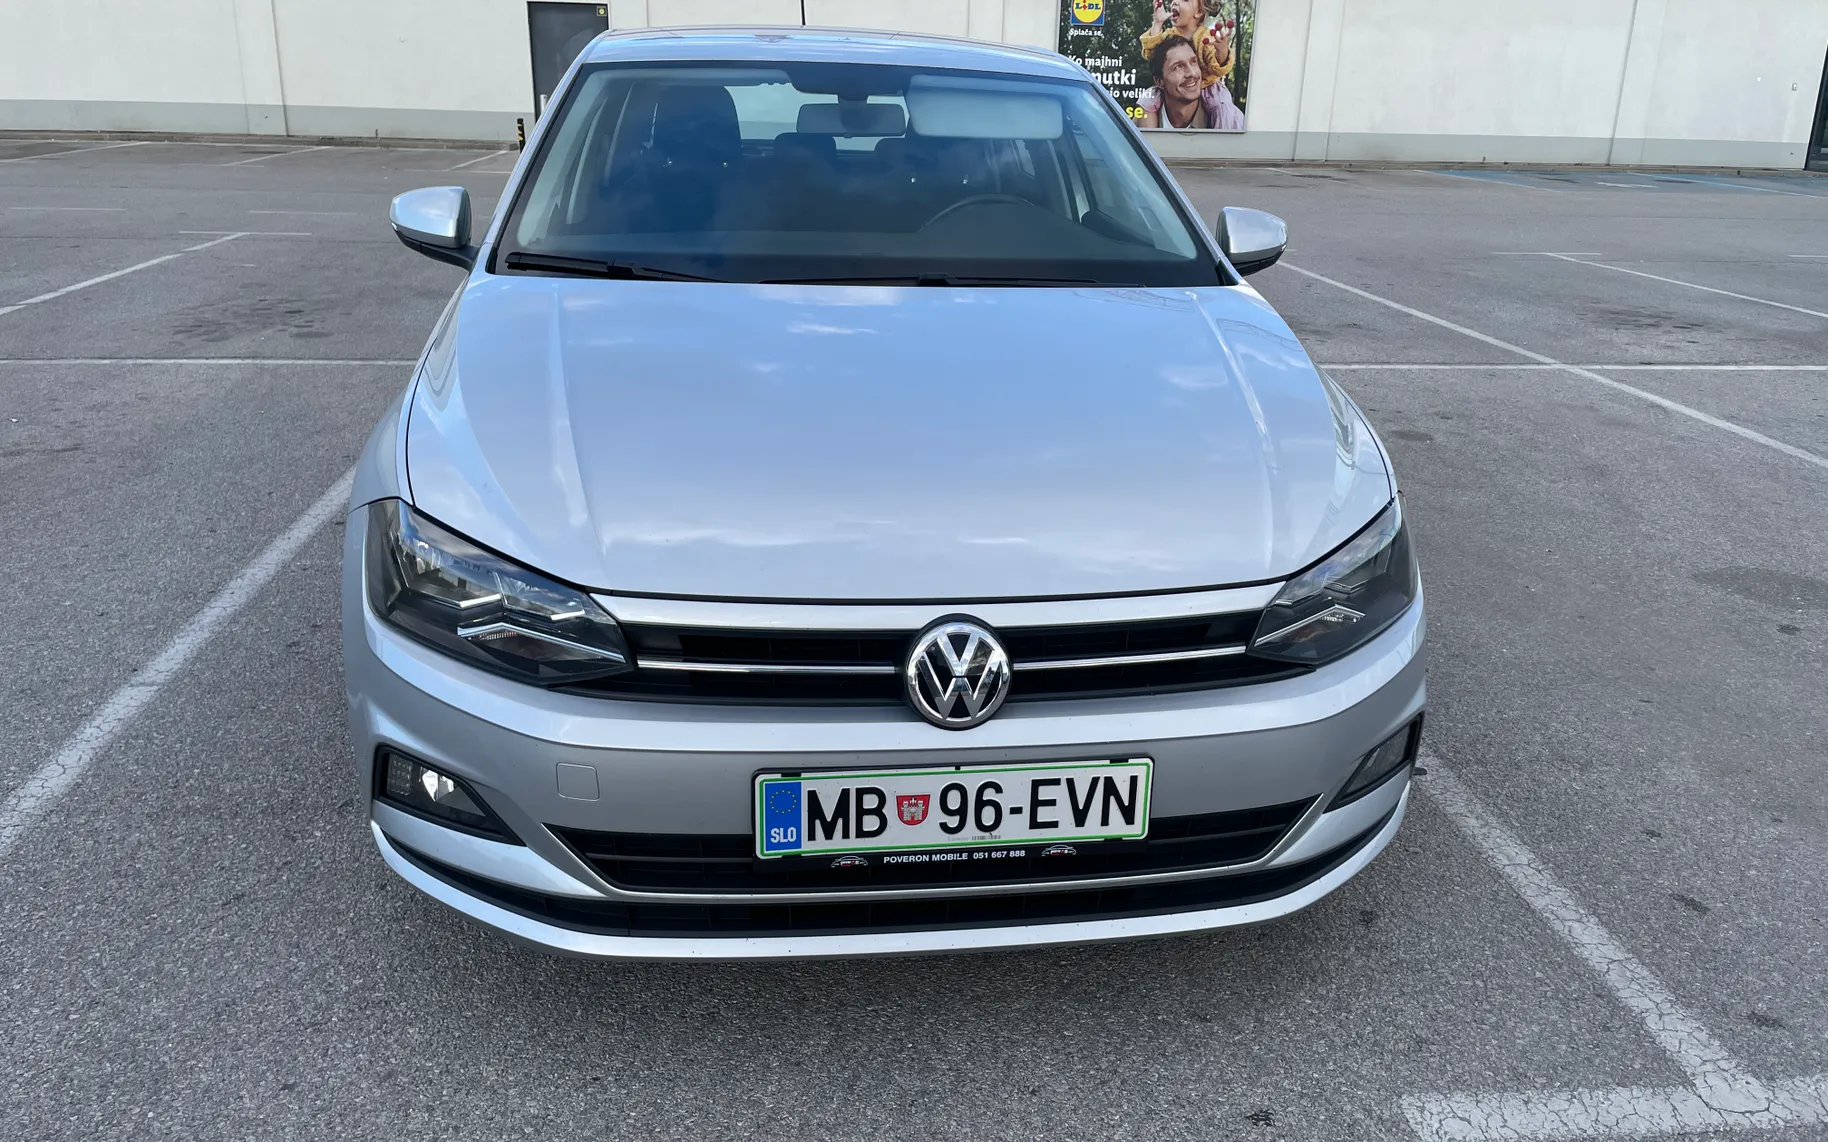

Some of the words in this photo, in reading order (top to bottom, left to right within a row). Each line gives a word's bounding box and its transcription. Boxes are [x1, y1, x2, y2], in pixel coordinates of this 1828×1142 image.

[1069, 28, 1093, 37] Splača
[1085, 55, 1123, 68] majhni
[1091, 68, 1137, 85] nutki
[1122, 87, 1155, 99] veliki.
[1125, 106, 1148, 118] se.
[807, 786, 888, 841] MB
[939, 775, 1139, 834] 96-EVN
[770, 827, 797, 843] SLO
[883, 854, 930, 864] POVERON
[932, 852, 969, 862] MOBILE
[973, 851, 989, 860] 051
[991, 850, 1007, 859] 667
